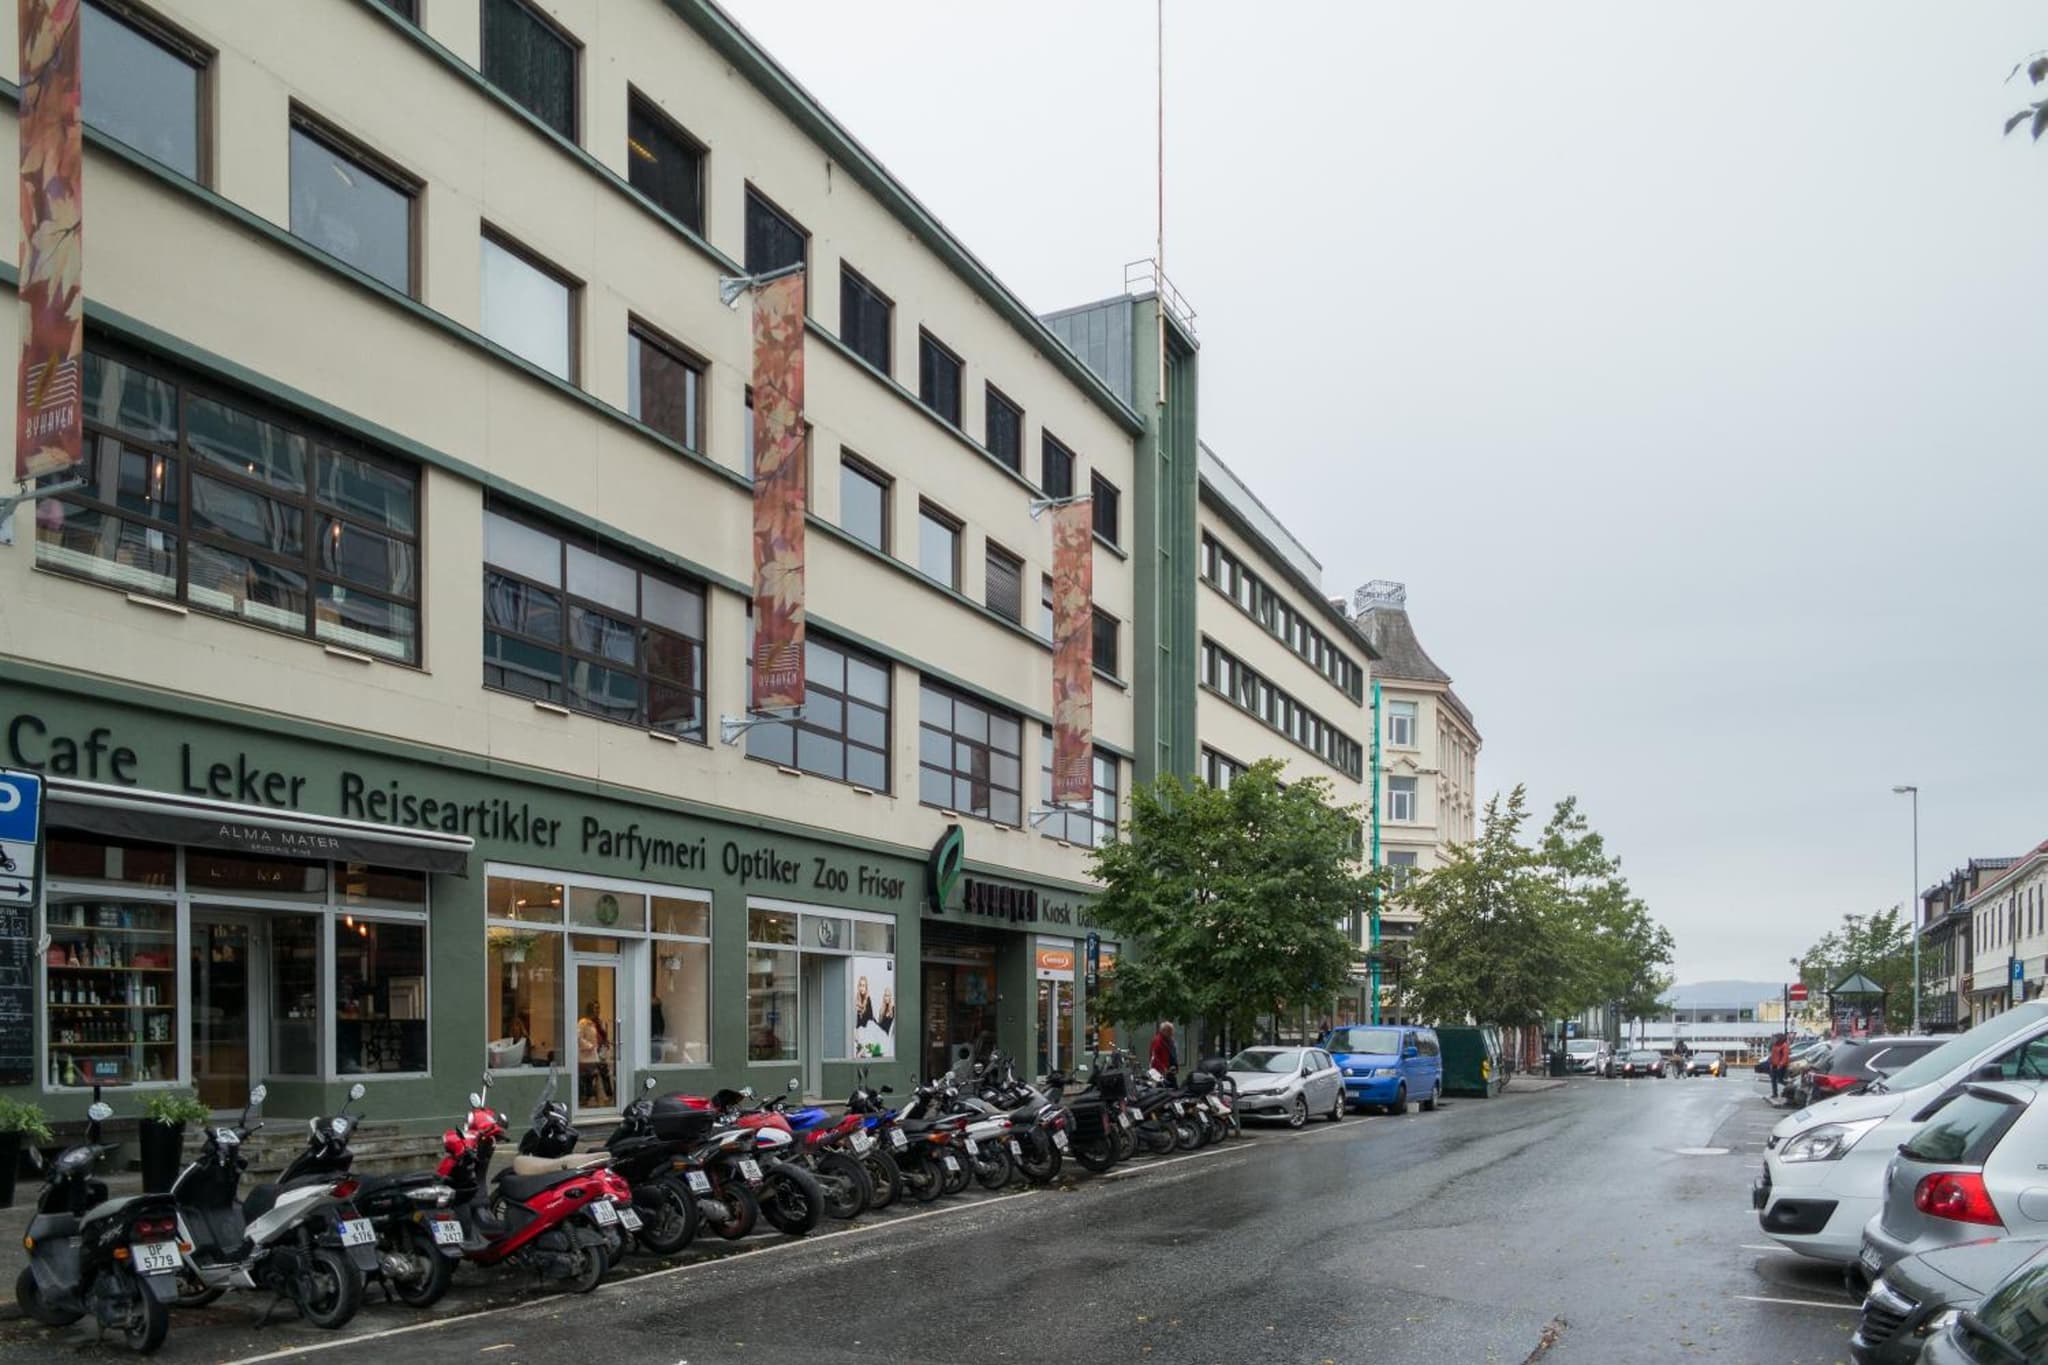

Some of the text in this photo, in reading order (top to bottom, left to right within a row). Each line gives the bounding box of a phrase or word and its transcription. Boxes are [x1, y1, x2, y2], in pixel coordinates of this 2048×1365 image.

[8, 714, 905, 901] Cafe Leker Reiseartikler Parfymeri Optiker Zoo Frisør
[220, 825, 340, 848] ALMA MATER
[1042, 898, 1071, 926] Kiosk
[2014, 963, 2021, 979] P
[144, 1254, 174, 1269] 5779
